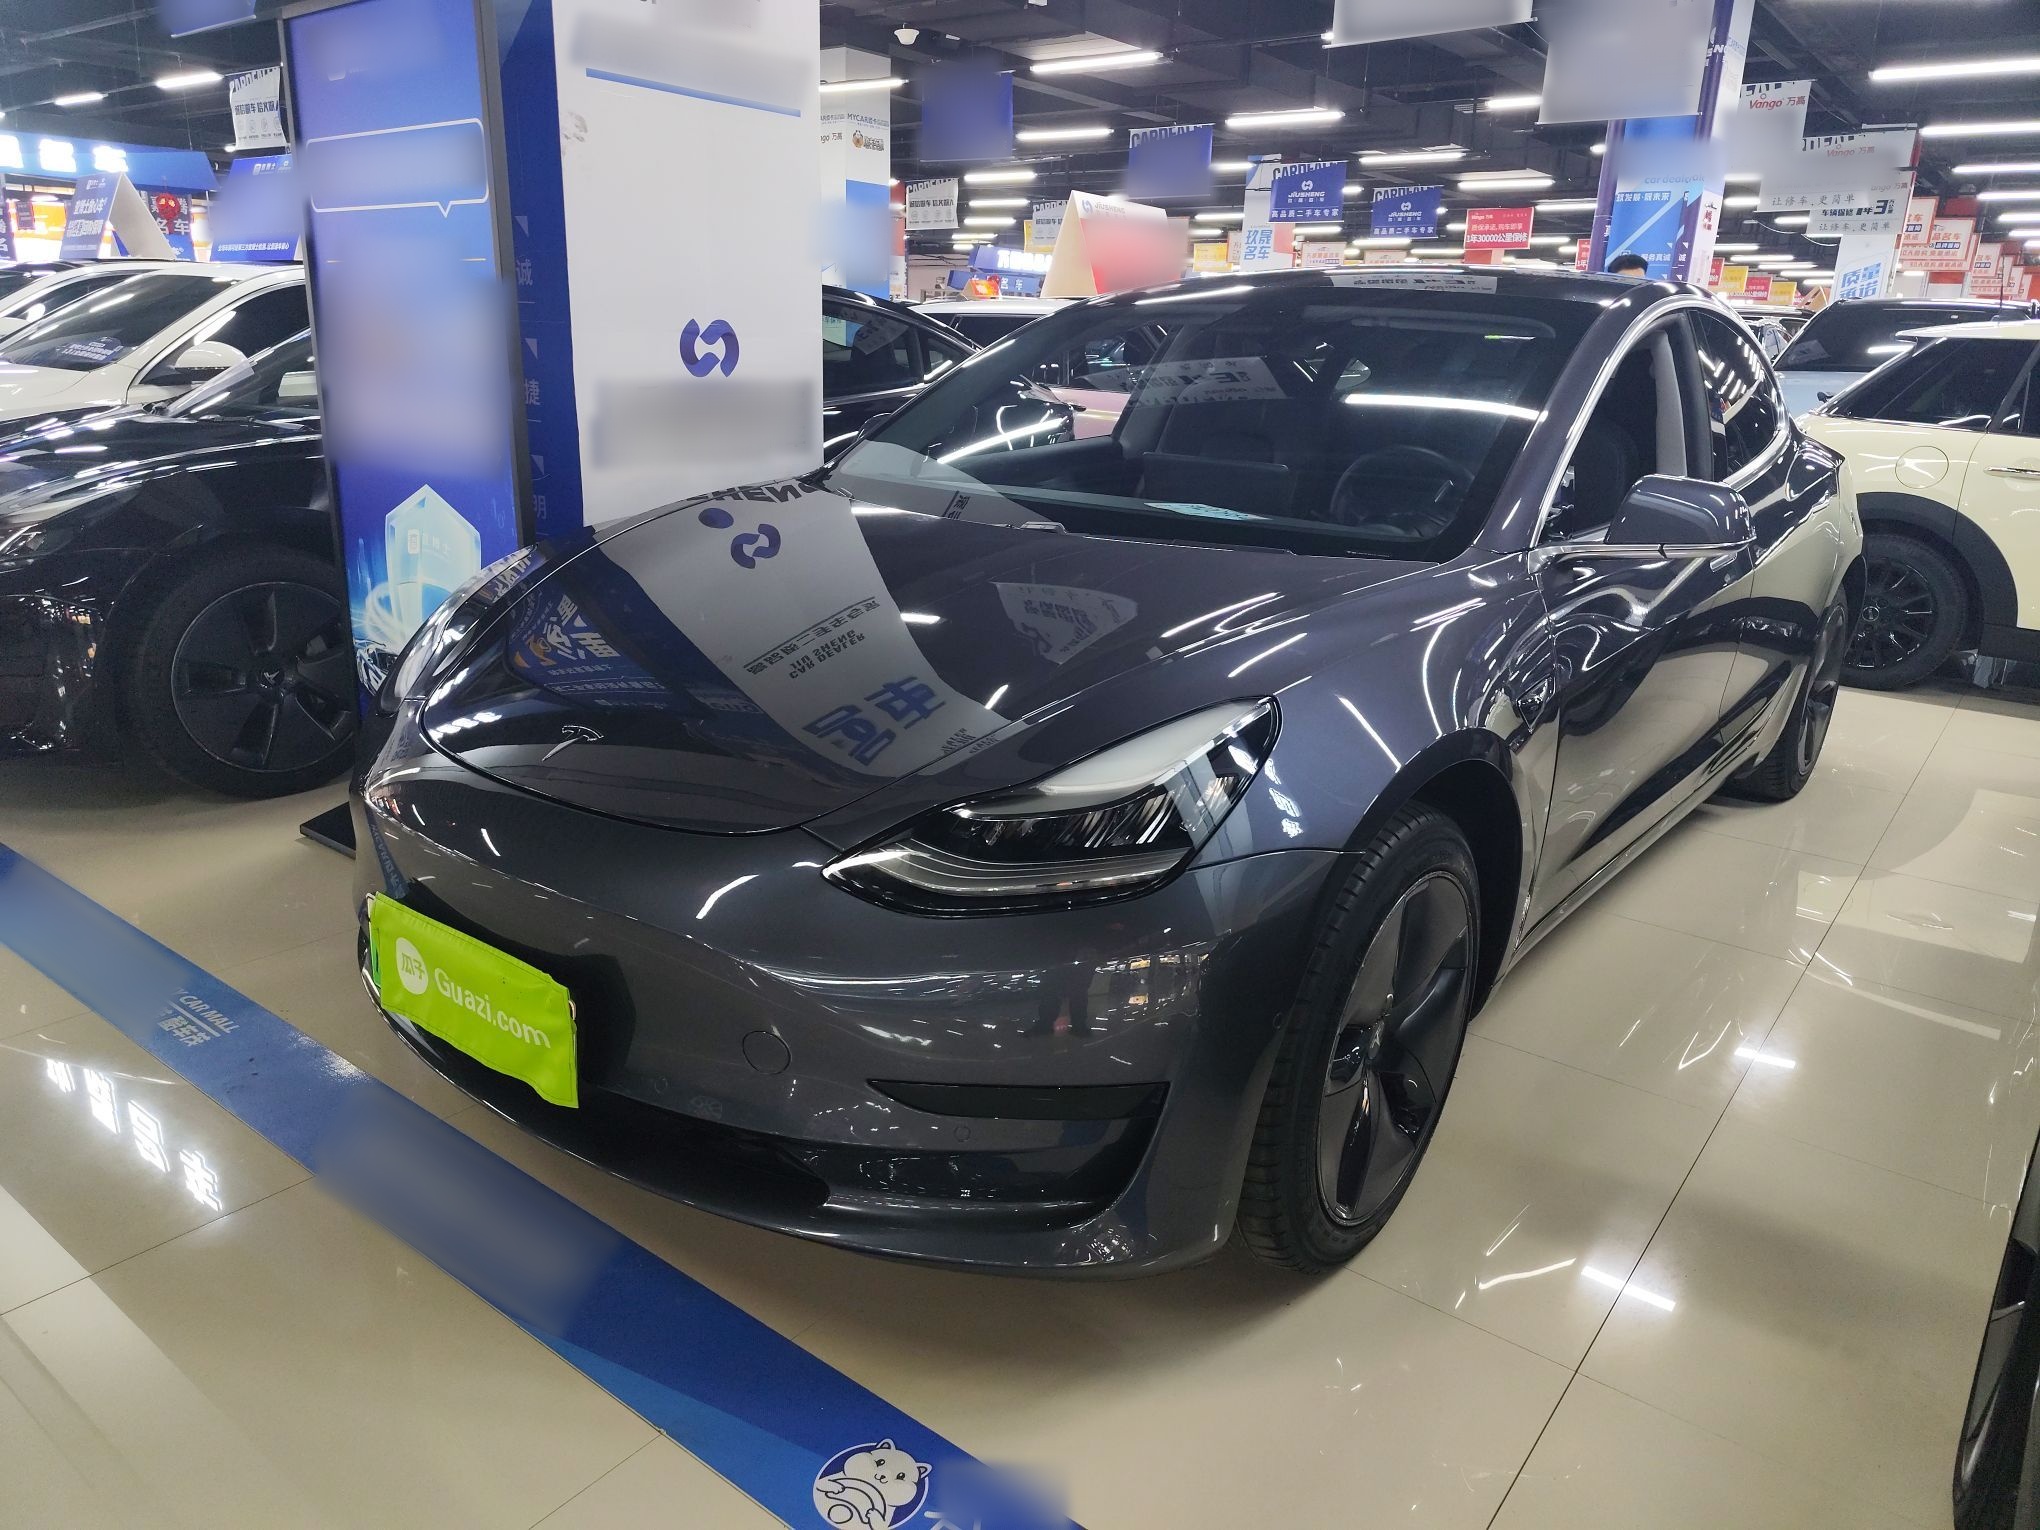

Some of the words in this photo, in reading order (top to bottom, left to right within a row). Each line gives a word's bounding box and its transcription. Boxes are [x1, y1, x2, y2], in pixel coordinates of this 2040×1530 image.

[1749, 98, 1783, 110] Vango
[1271, 208, 1340, 218] 高品质二手车专家
[1244, 245, 1271, 261] 名车
[515, 259, 534, 286] 诚
[523, 379, 541, 406] 捷
[401, 951, 426, 979] 瓜子
[179, 995, 211, 1013] CAR
[199, 1009, 241, 1034] MALL
[434, 967, 551, 1049] Guazi.com
